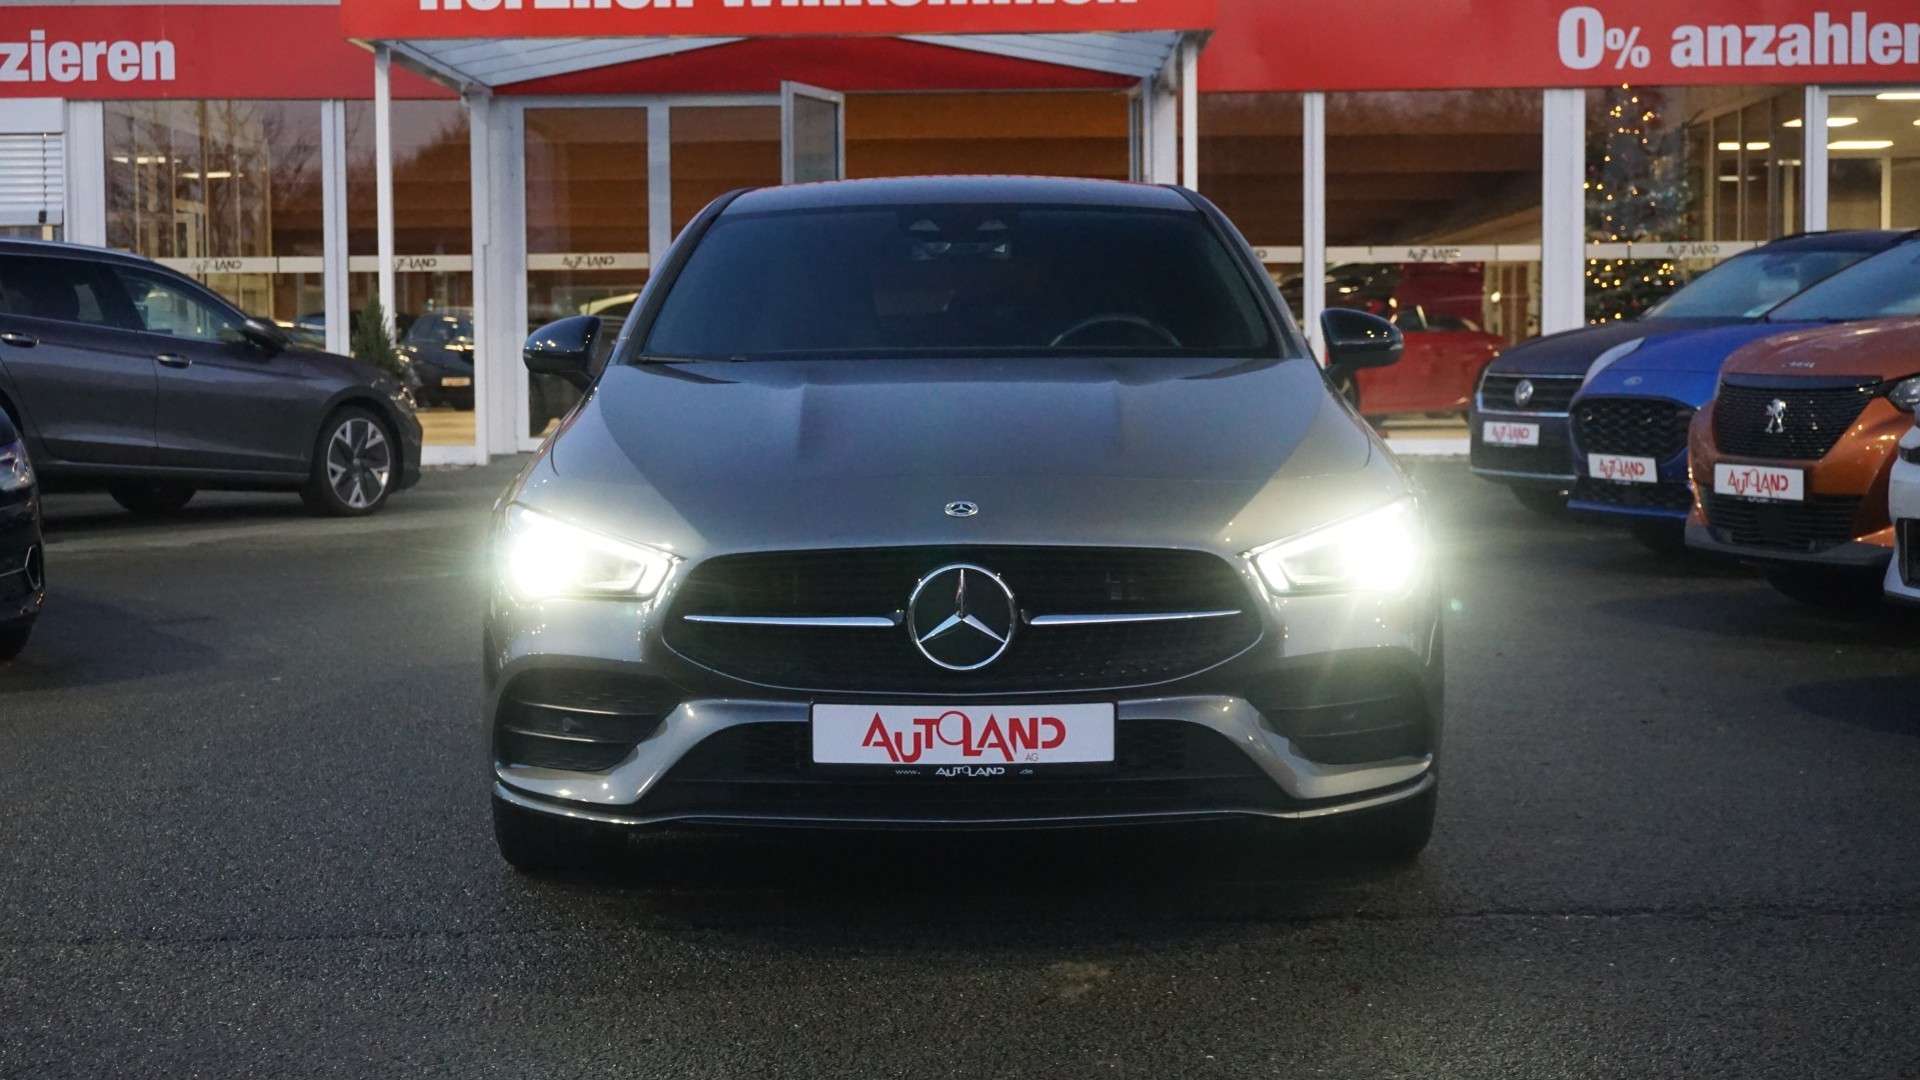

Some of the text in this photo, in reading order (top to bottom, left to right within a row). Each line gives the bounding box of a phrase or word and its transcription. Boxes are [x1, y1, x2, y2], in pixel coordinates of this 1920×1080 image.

[1558, 6, 1650, 70] 0%
[0, 29, 176, 82] zieren
[1407, 246, 1461, 262] AUTLAN
[1665, 244, 1720, 257] AUTLAND
[191, 259, 242, 273] UTLAND
[562, 255, 616, 269] AUTLAND
[1599, 458, 1646, 480] AUTLAND
[1727, 467, 1789, 497] AUTOLAND
[862, 711, 1066, 763] AUTOLAND
[1025, 753, 1039, 762] AG
[935, 765, 1005, 777] AUTOLAND
